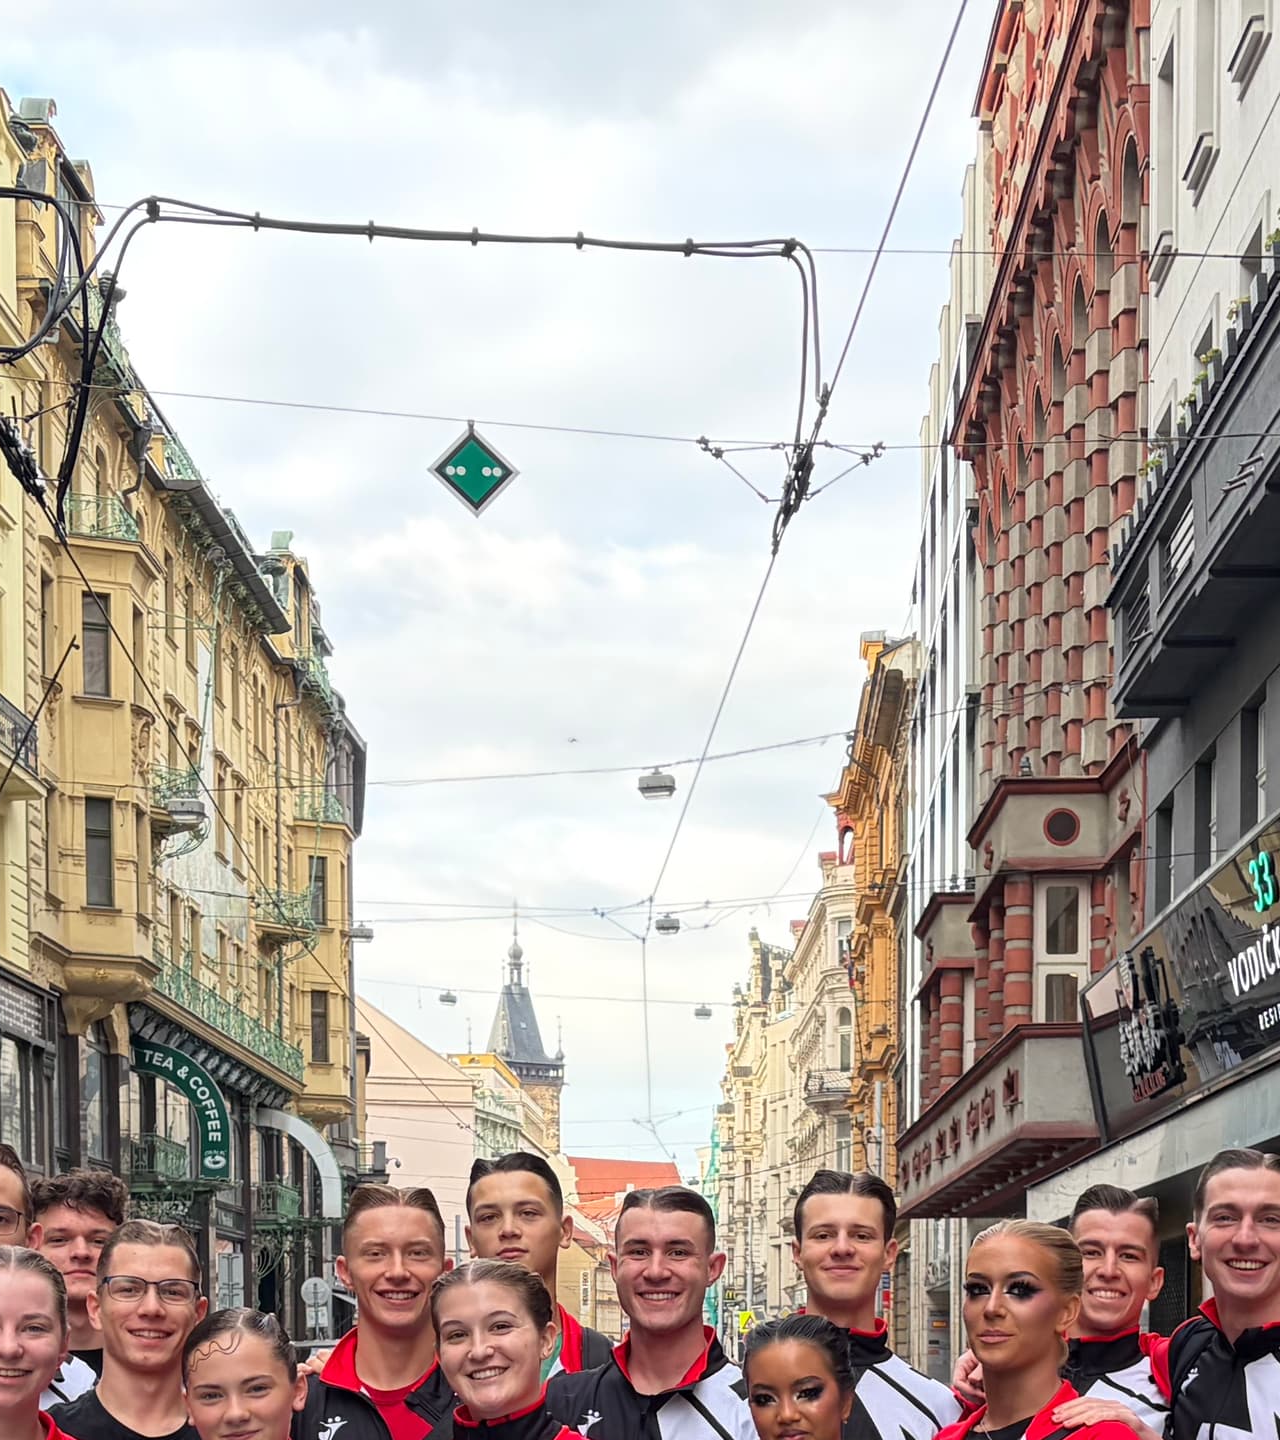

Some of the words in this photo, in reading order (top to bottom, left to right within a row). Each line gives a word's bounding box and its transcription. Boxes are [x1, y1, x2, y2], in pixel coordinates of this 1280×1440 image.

[1249, 851, 1276, 912] 33
[143, 1050, 174, 1071] TEA
[177, 1066, 189, 1080] &
[189, 1077, 221, 1142] COFFEE
